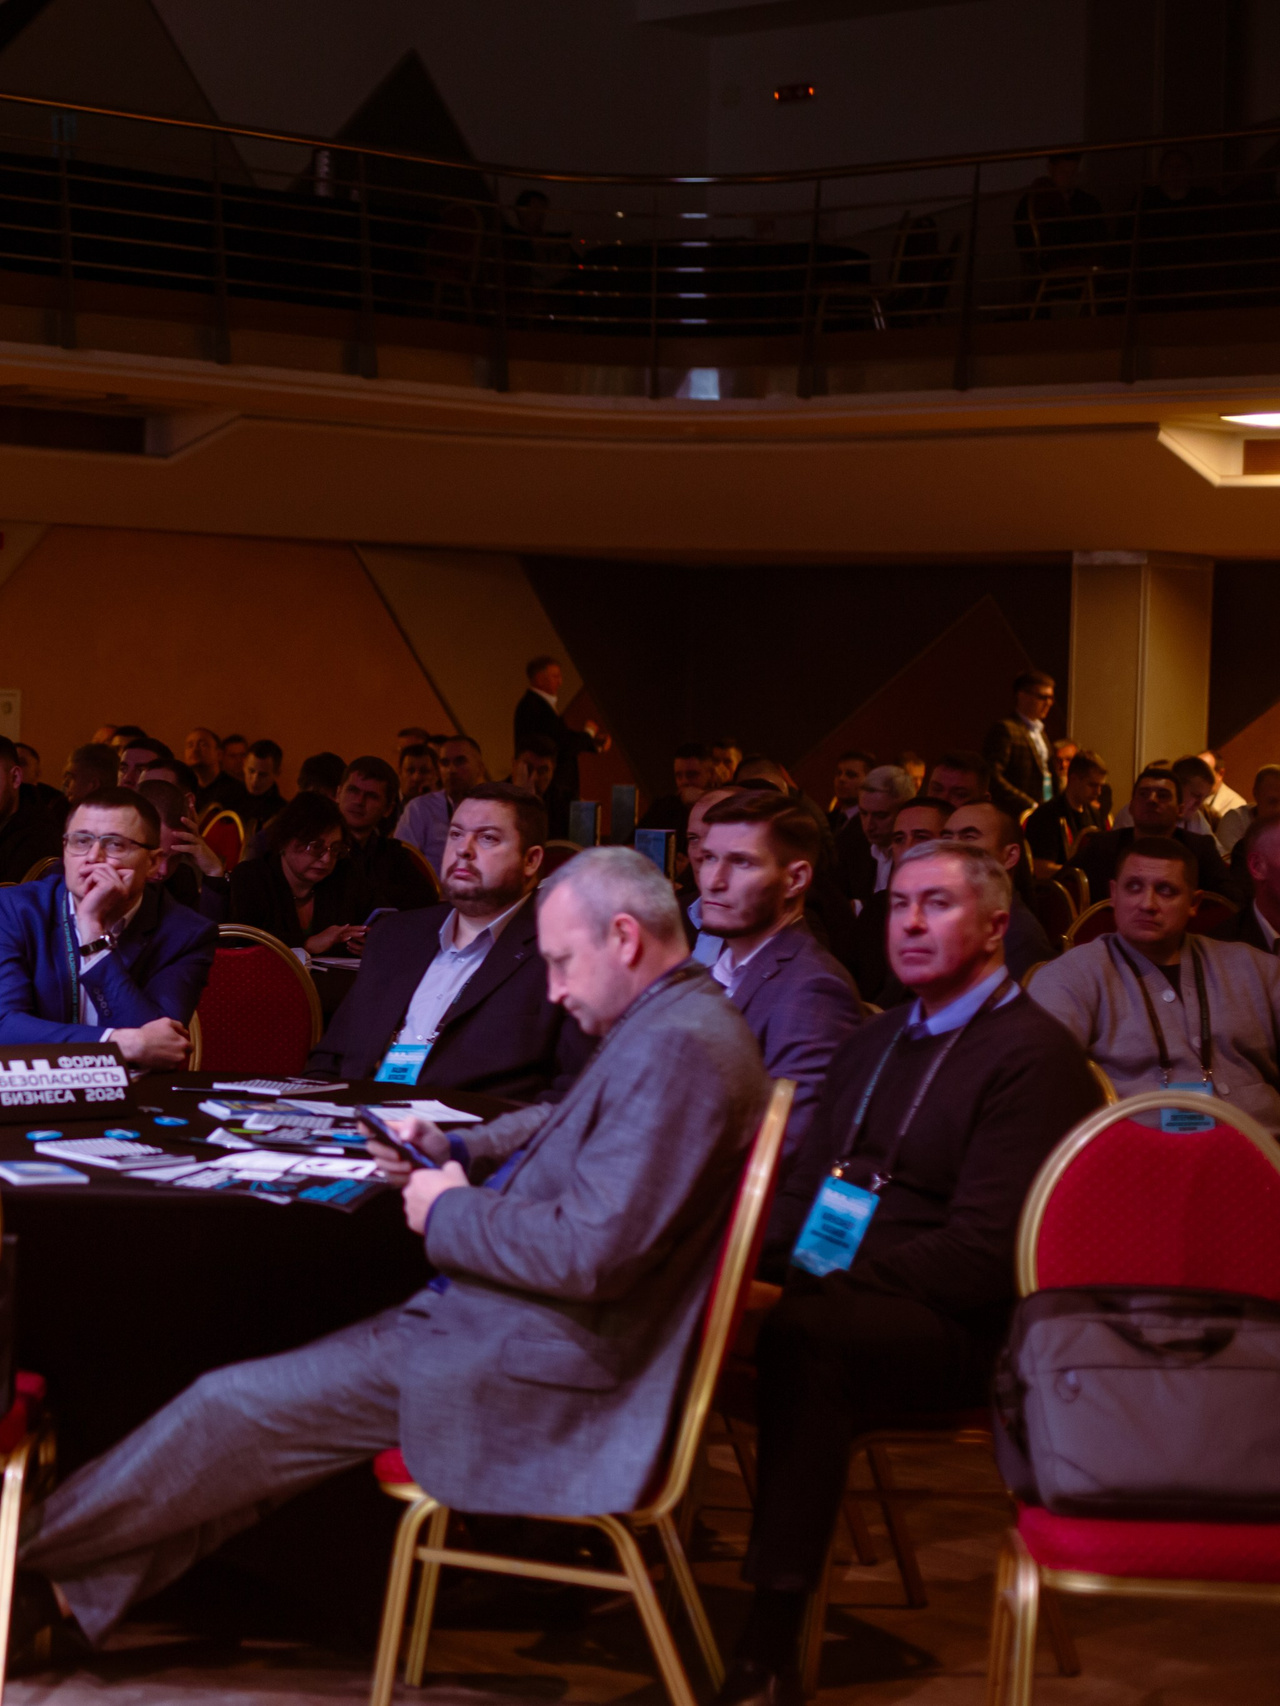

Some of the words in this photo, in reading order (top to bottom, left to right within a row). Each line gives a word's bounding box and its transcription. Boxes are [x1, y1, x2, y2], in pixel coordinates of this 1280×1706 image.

[57, 1054, 117, 1069] ФОРУМ
[0, 1089, 76, 1106] БИЗНЕСА
[84, 1087, 126, 1102] 2024
